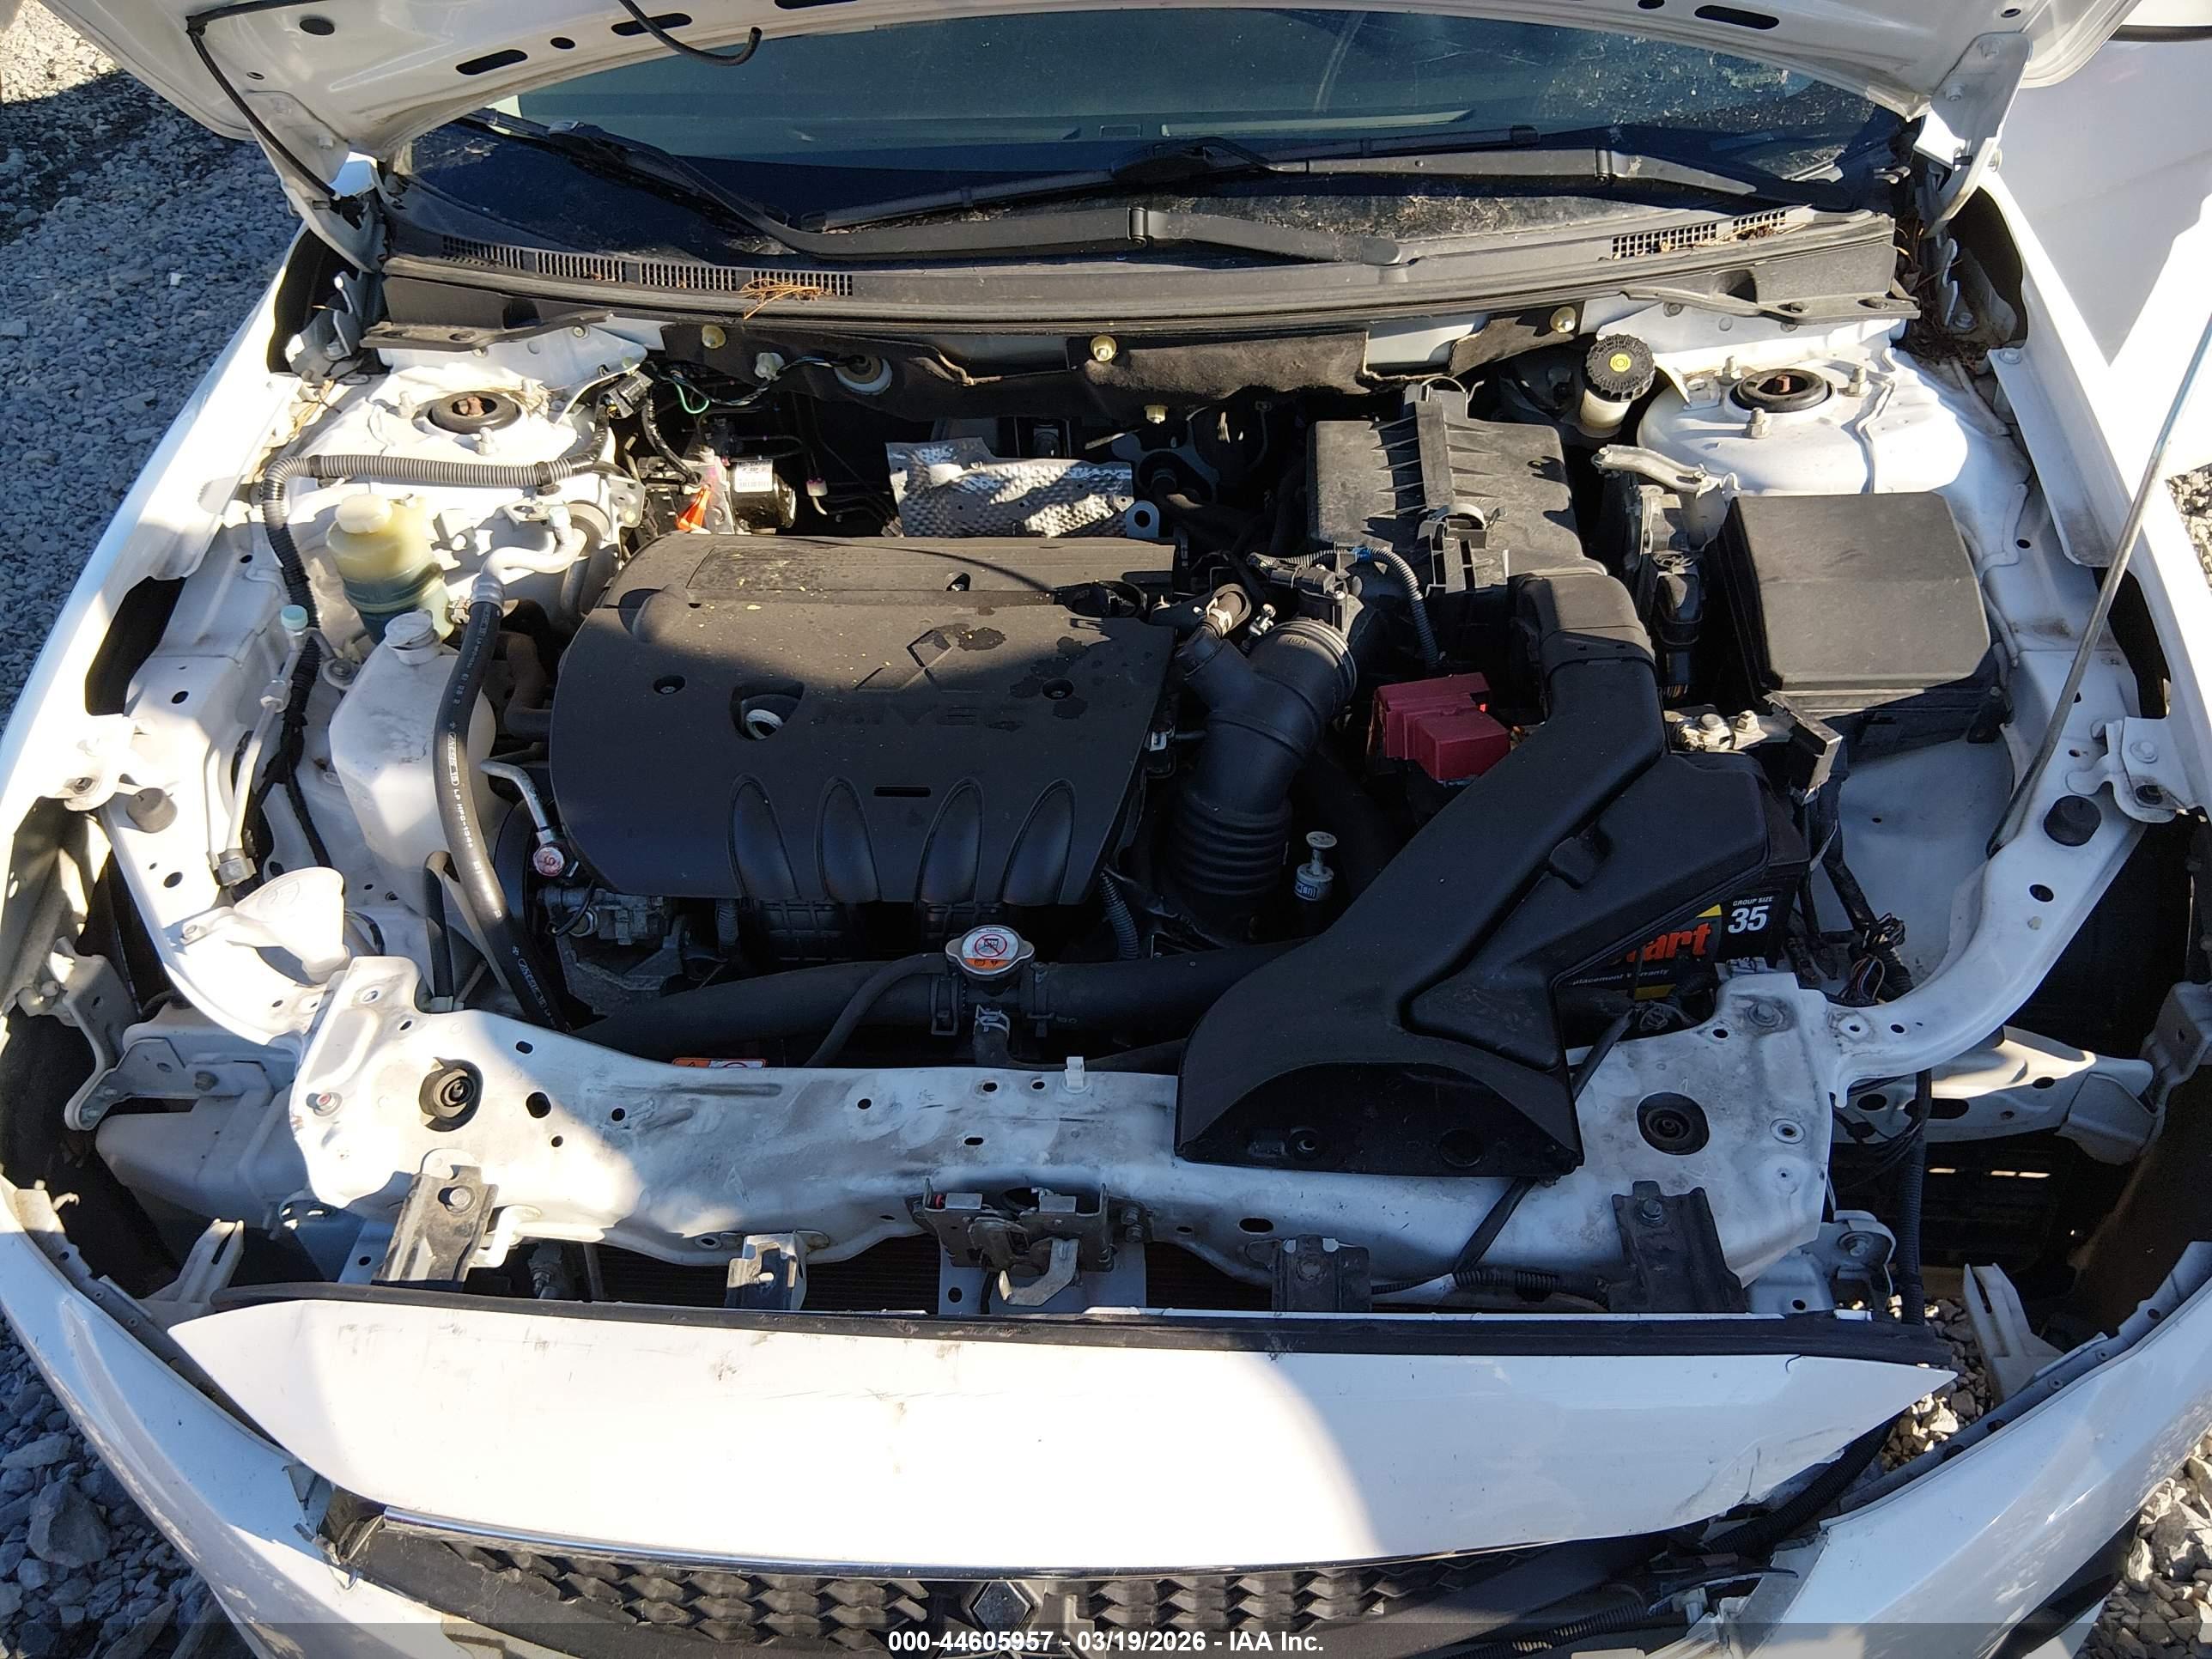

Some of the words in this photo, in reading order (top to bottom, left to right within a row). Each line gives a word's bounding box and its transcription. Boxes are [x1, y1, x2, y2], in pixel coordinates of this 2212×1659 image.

[1733, 898, 1758, 907] GROUP
[1758, 896, 1773, 904] SIZE
[1728, 905, 1770, 933] 35
